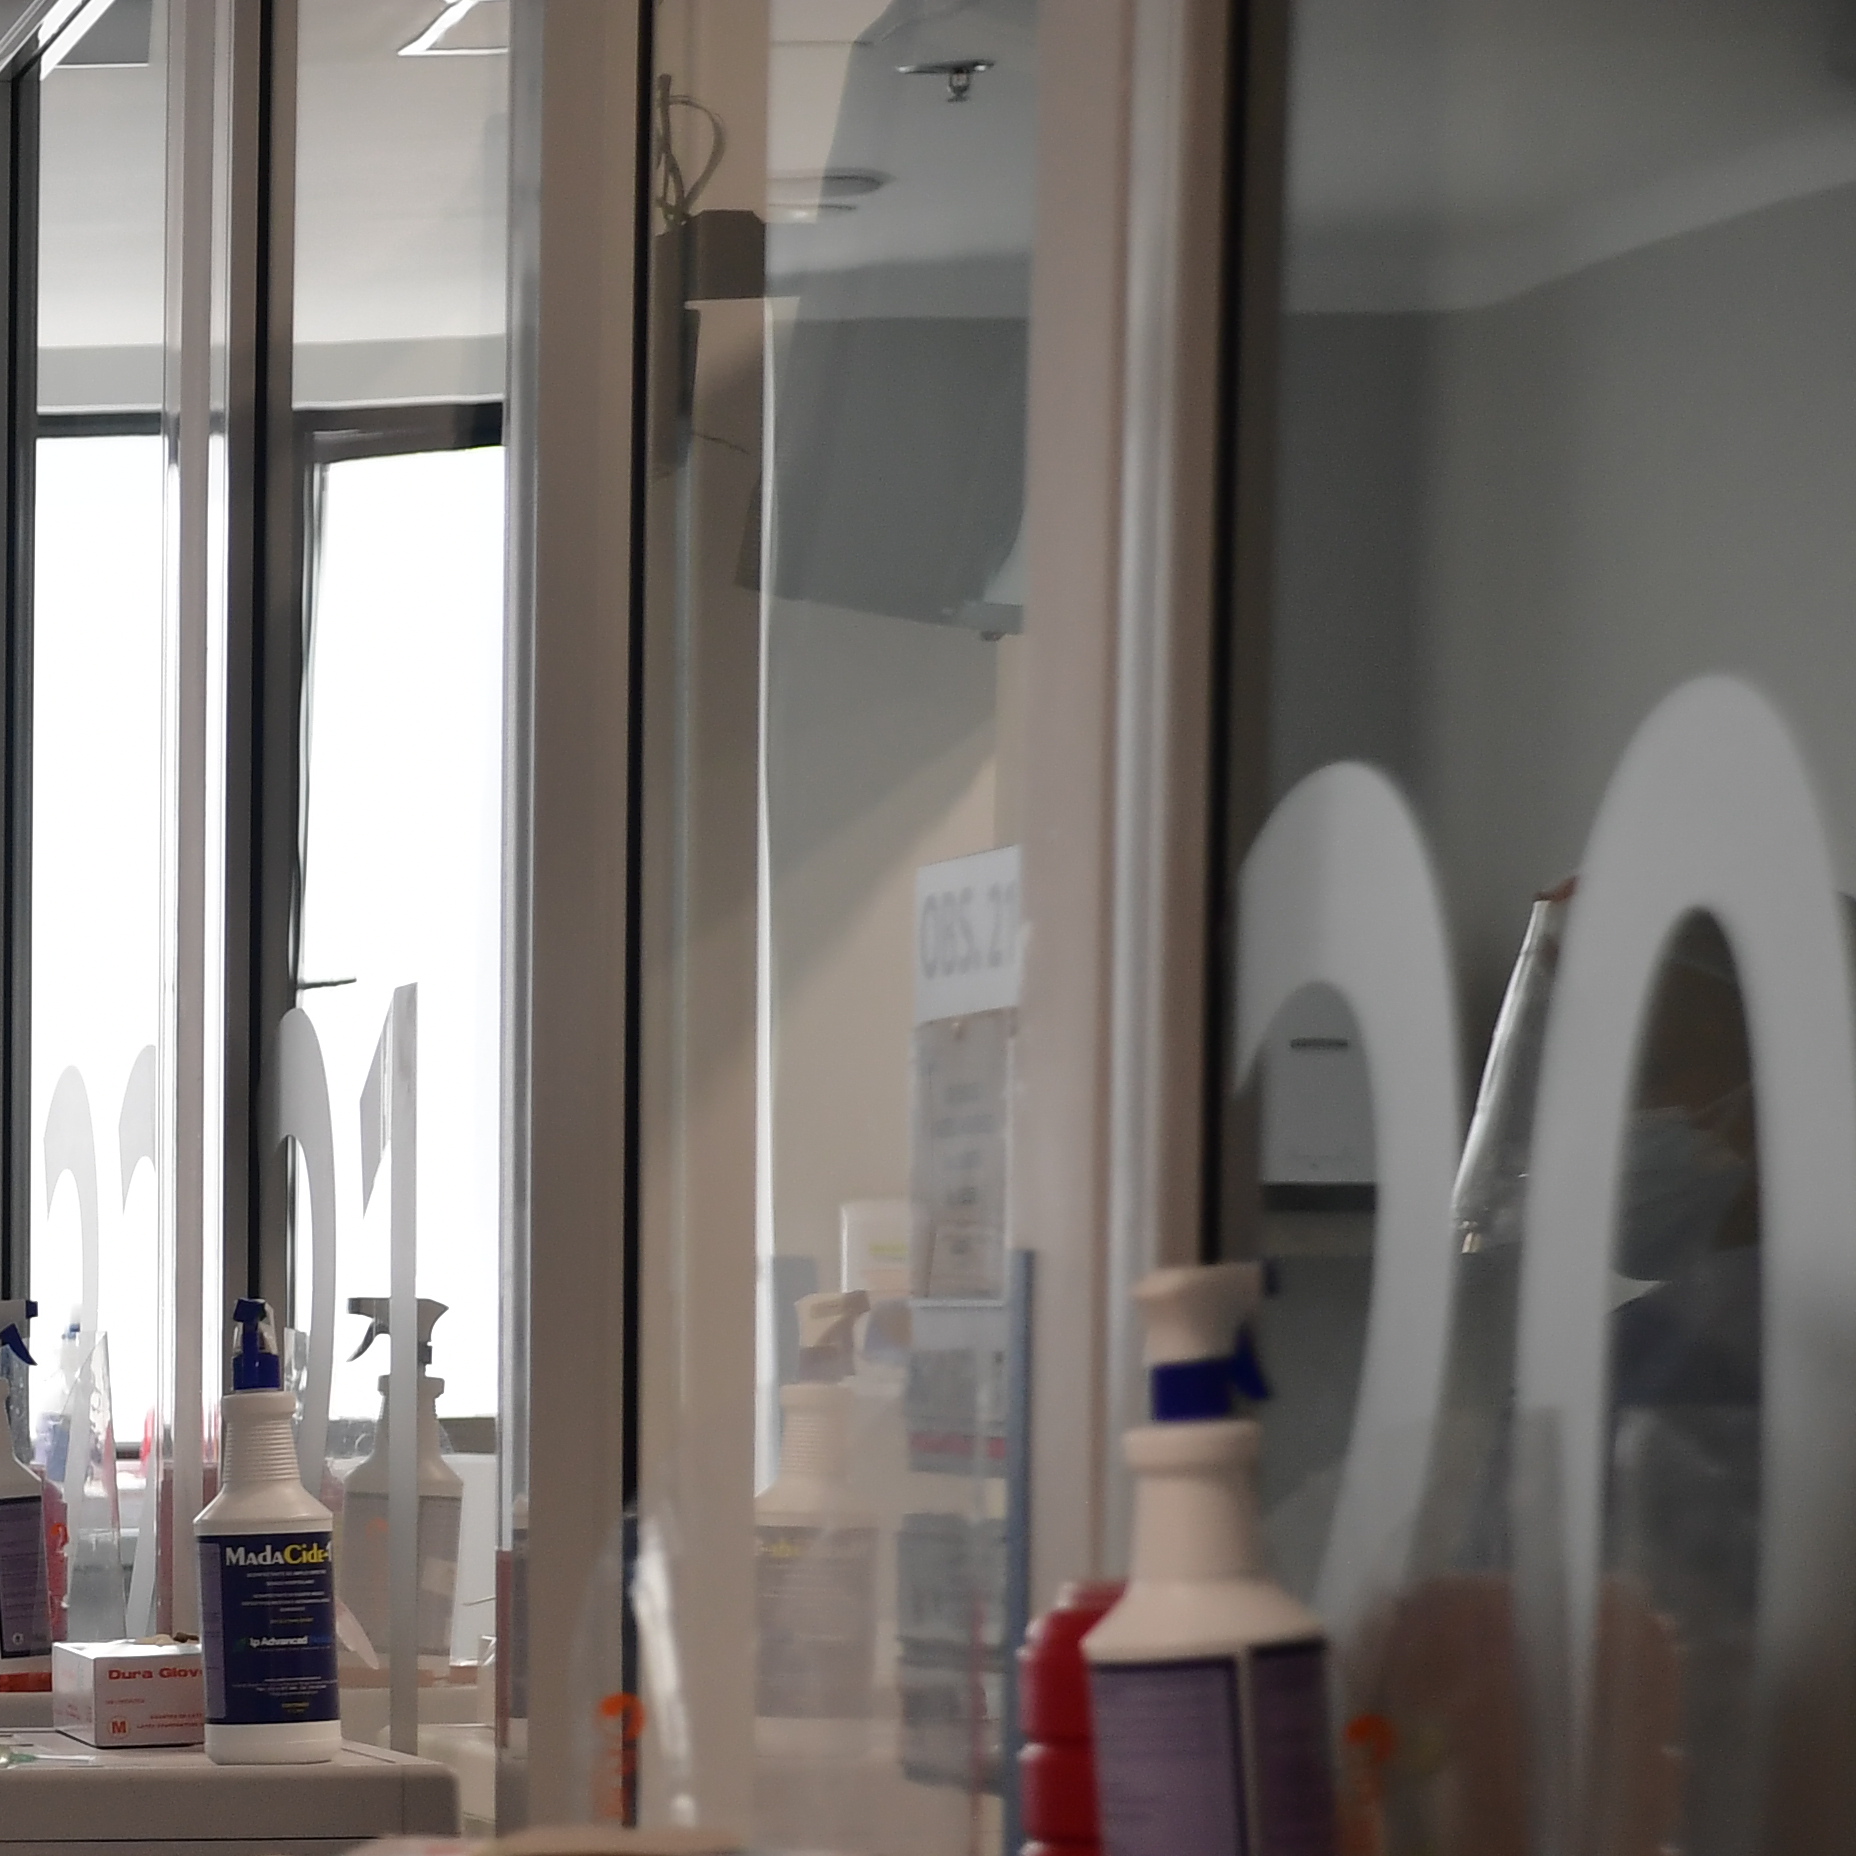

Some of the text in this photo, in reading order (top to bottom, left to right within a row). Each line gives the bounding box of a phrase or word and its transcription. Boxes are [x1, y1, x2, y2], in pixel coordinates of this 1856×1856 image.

[261, 1635, 308, 1647] Advanced
[108, 1669, 153, 1680] Dura
[112, 1720, 127, 1734] M
